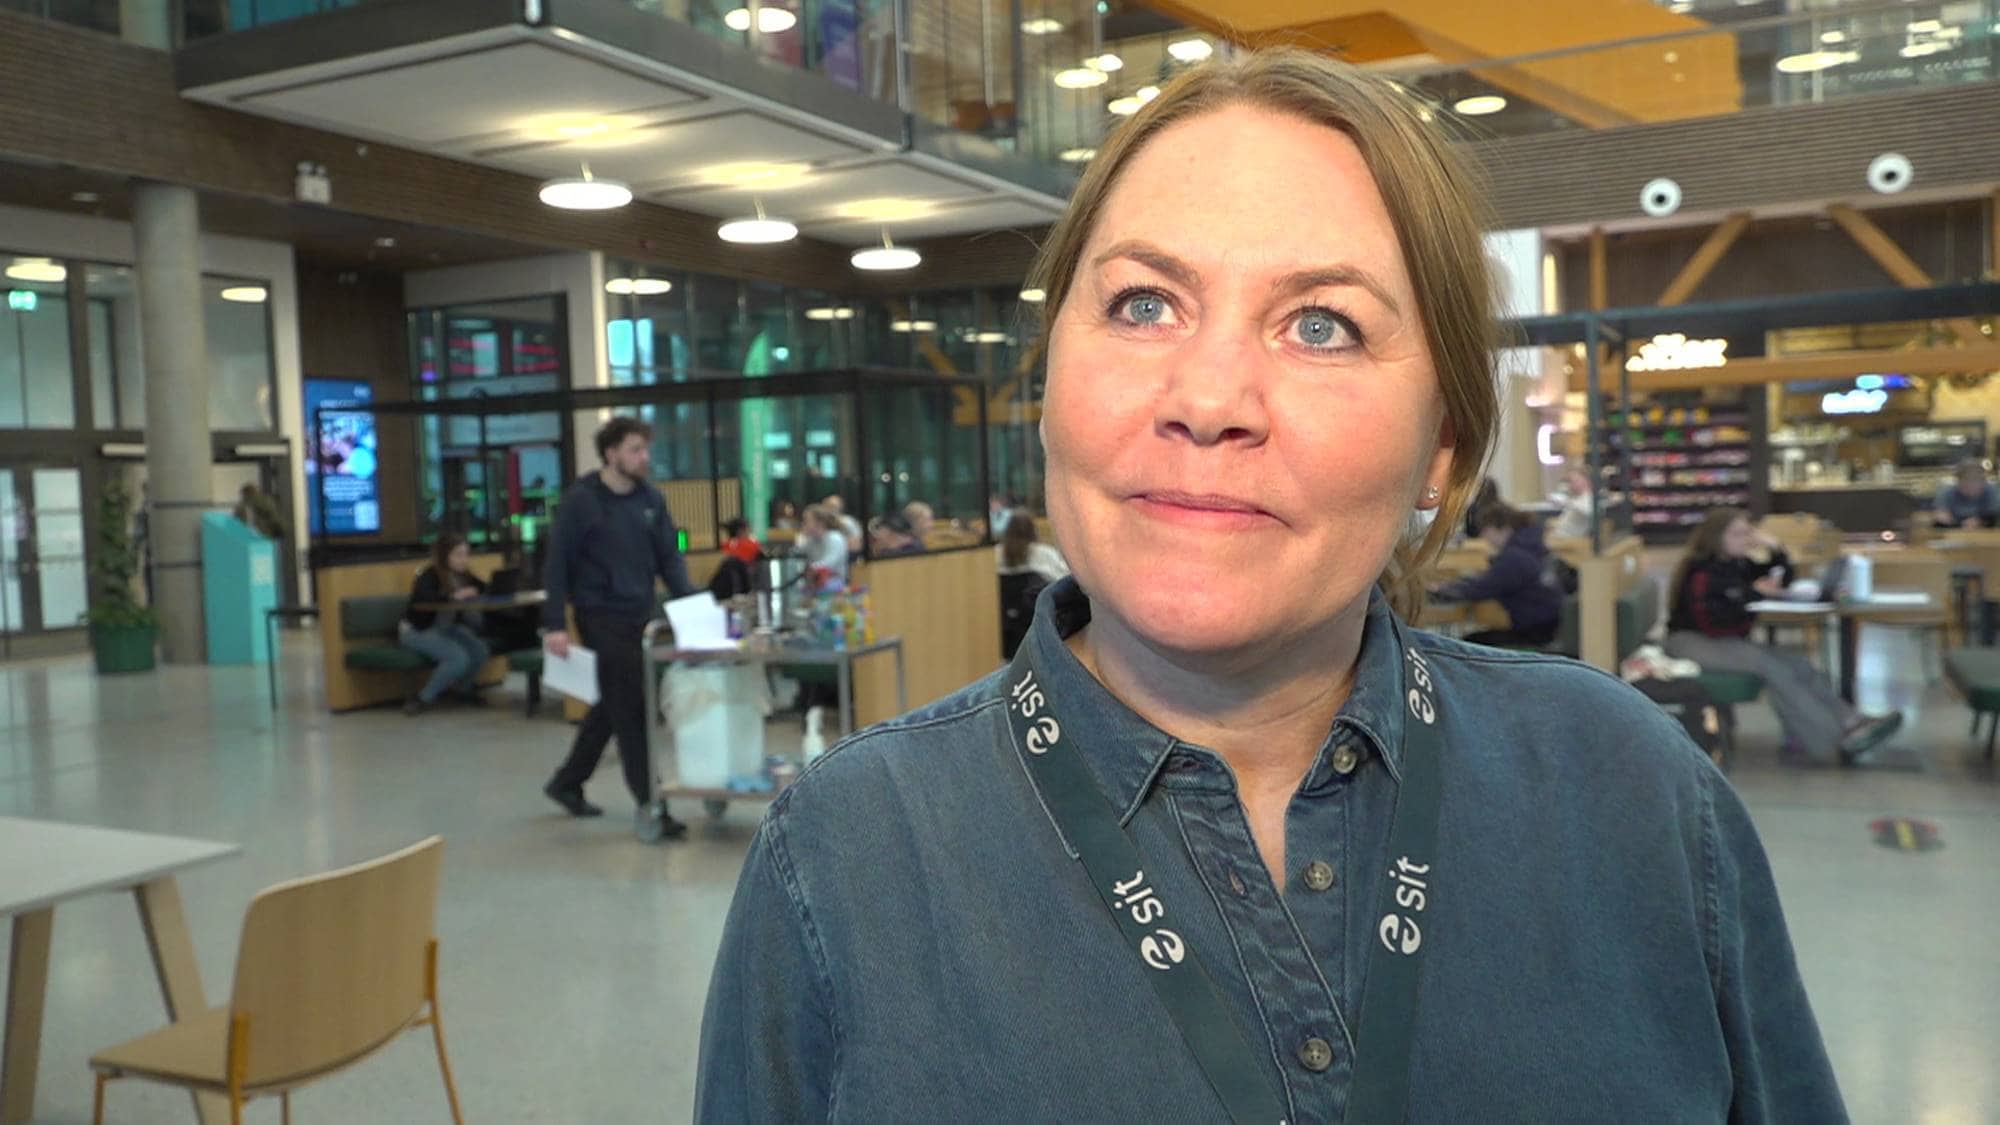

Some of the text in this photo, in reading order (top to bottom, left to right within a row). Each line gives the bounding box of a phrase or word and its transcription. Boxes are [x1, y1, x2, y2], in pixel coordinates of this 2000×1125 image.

[1011, 670, 1045, 718] sit
[1406, 647, 1434, 691] sit
[1112, 870, 1164, 924] sit
[1388, 856, 1430, 911] sit
